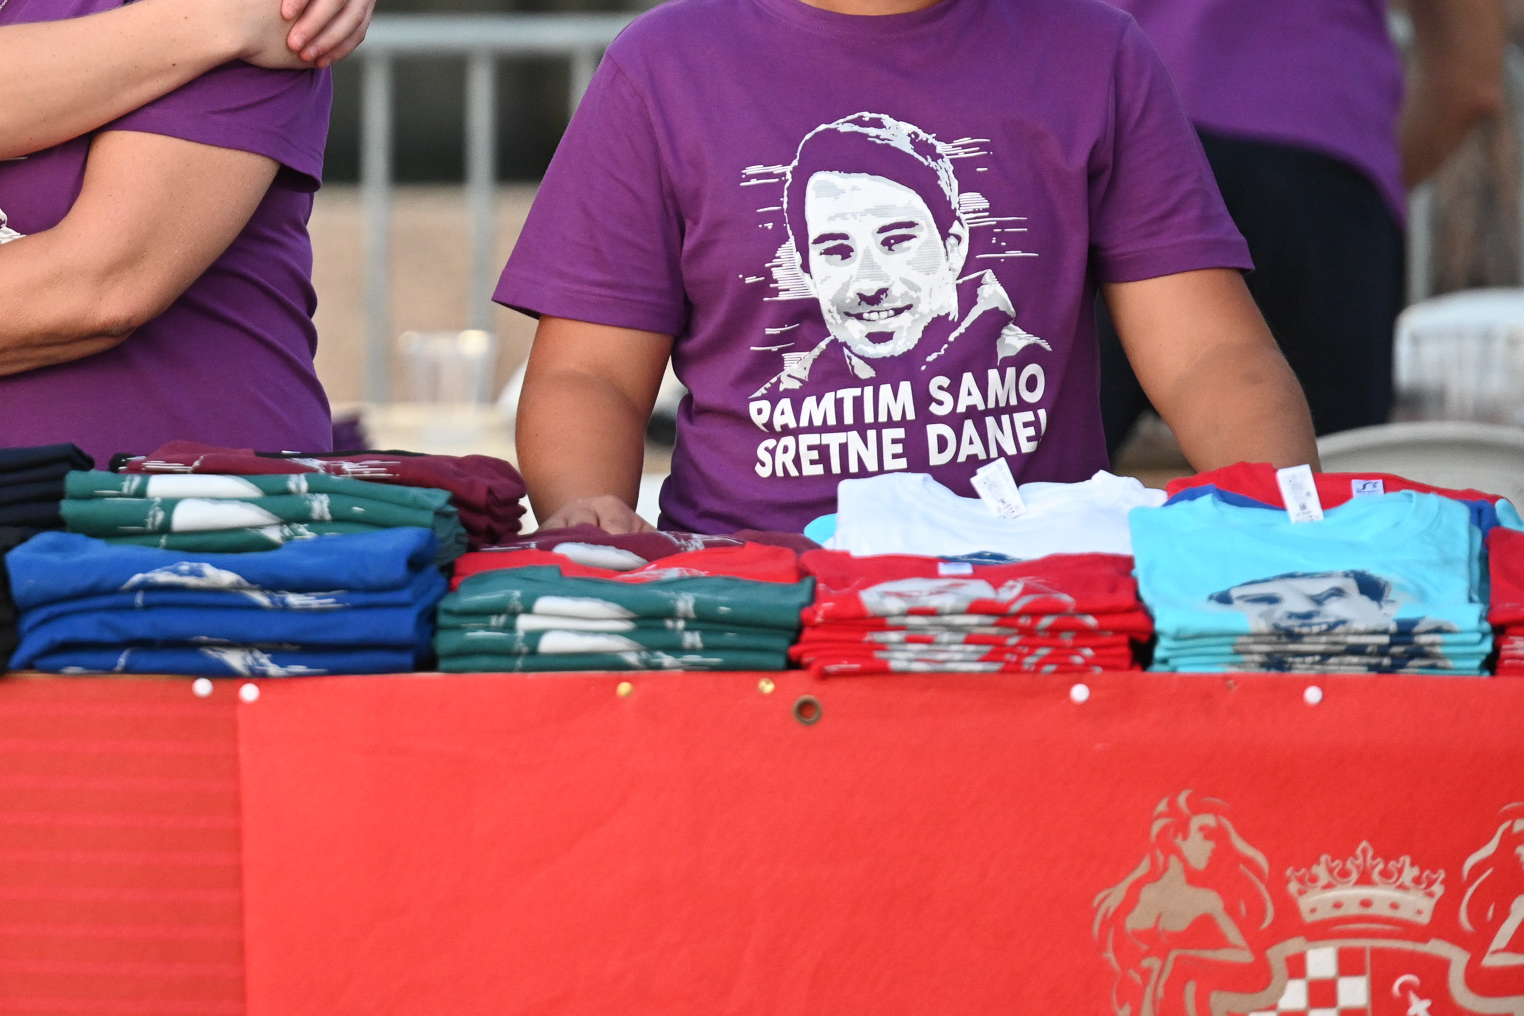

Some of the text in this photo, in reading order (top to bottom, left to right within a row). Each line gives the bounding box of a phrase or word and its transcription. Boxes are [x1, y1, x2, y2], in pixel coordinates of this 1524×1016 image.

[749, 363, 1046, 433] PAMTIM SAMO
[754, 427, 908, 478] SRETNE
